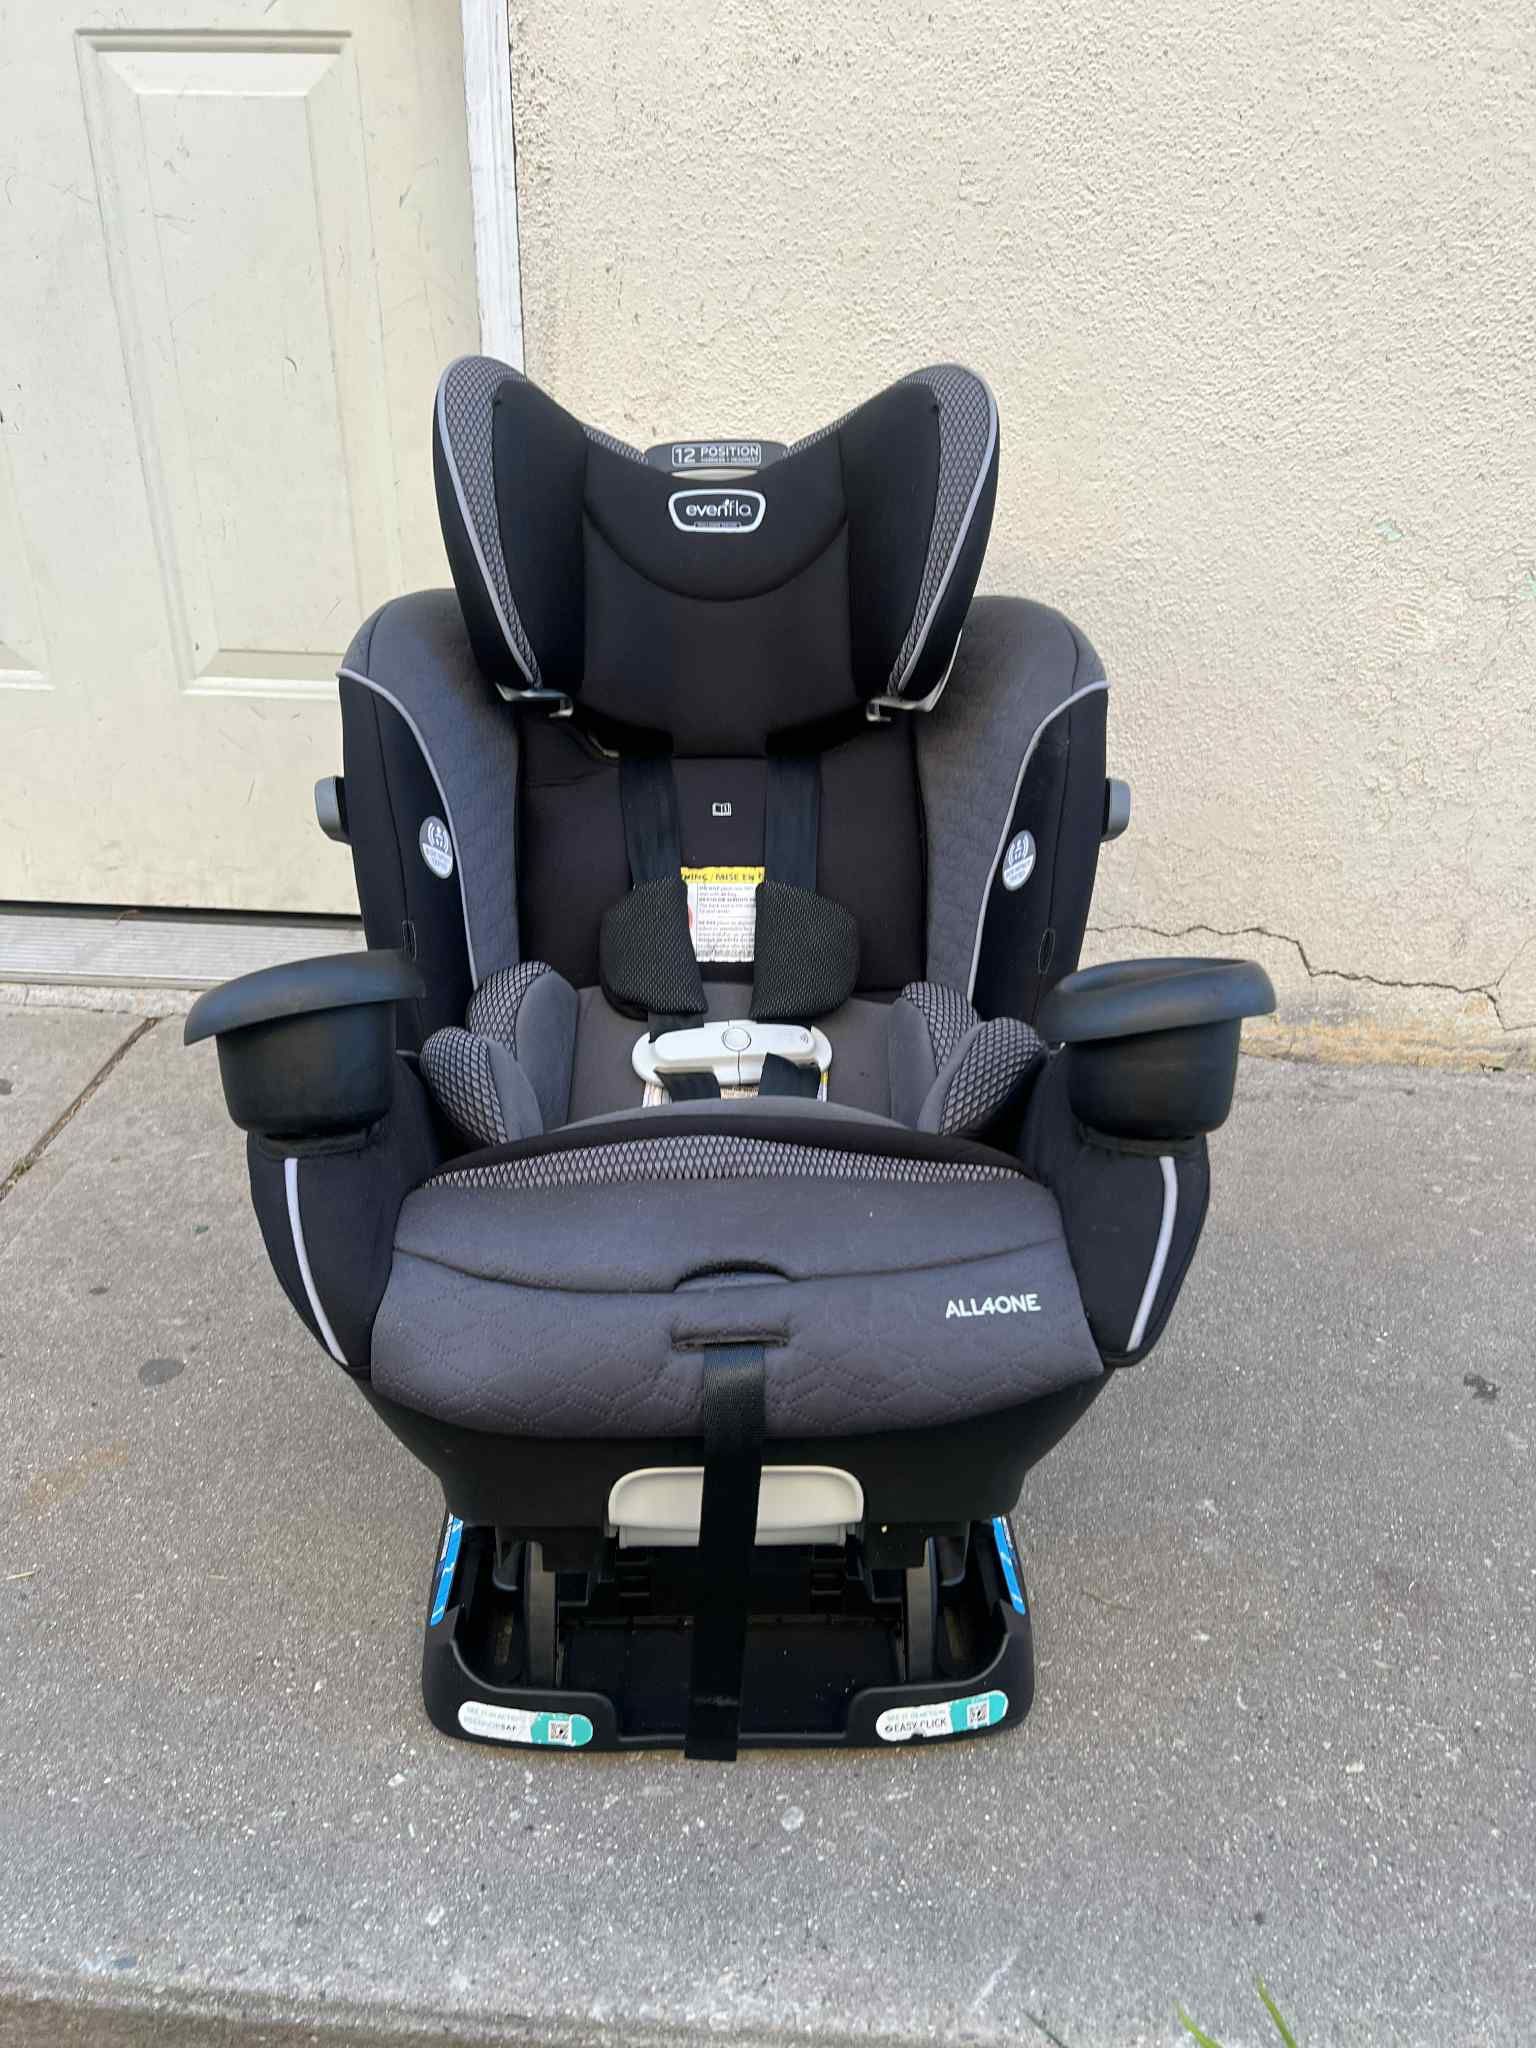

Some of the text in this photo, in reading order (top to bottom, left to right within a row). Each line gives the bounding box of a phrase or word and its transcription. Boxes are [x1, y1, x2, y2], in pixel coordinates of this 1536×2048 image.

[675, 447, 696, 463] 12
[701, 446, 759, 457] POSITION
[686, 499, 752, 517] evenflo
[945, 1293, 1042, 1319] ALL4ONE
